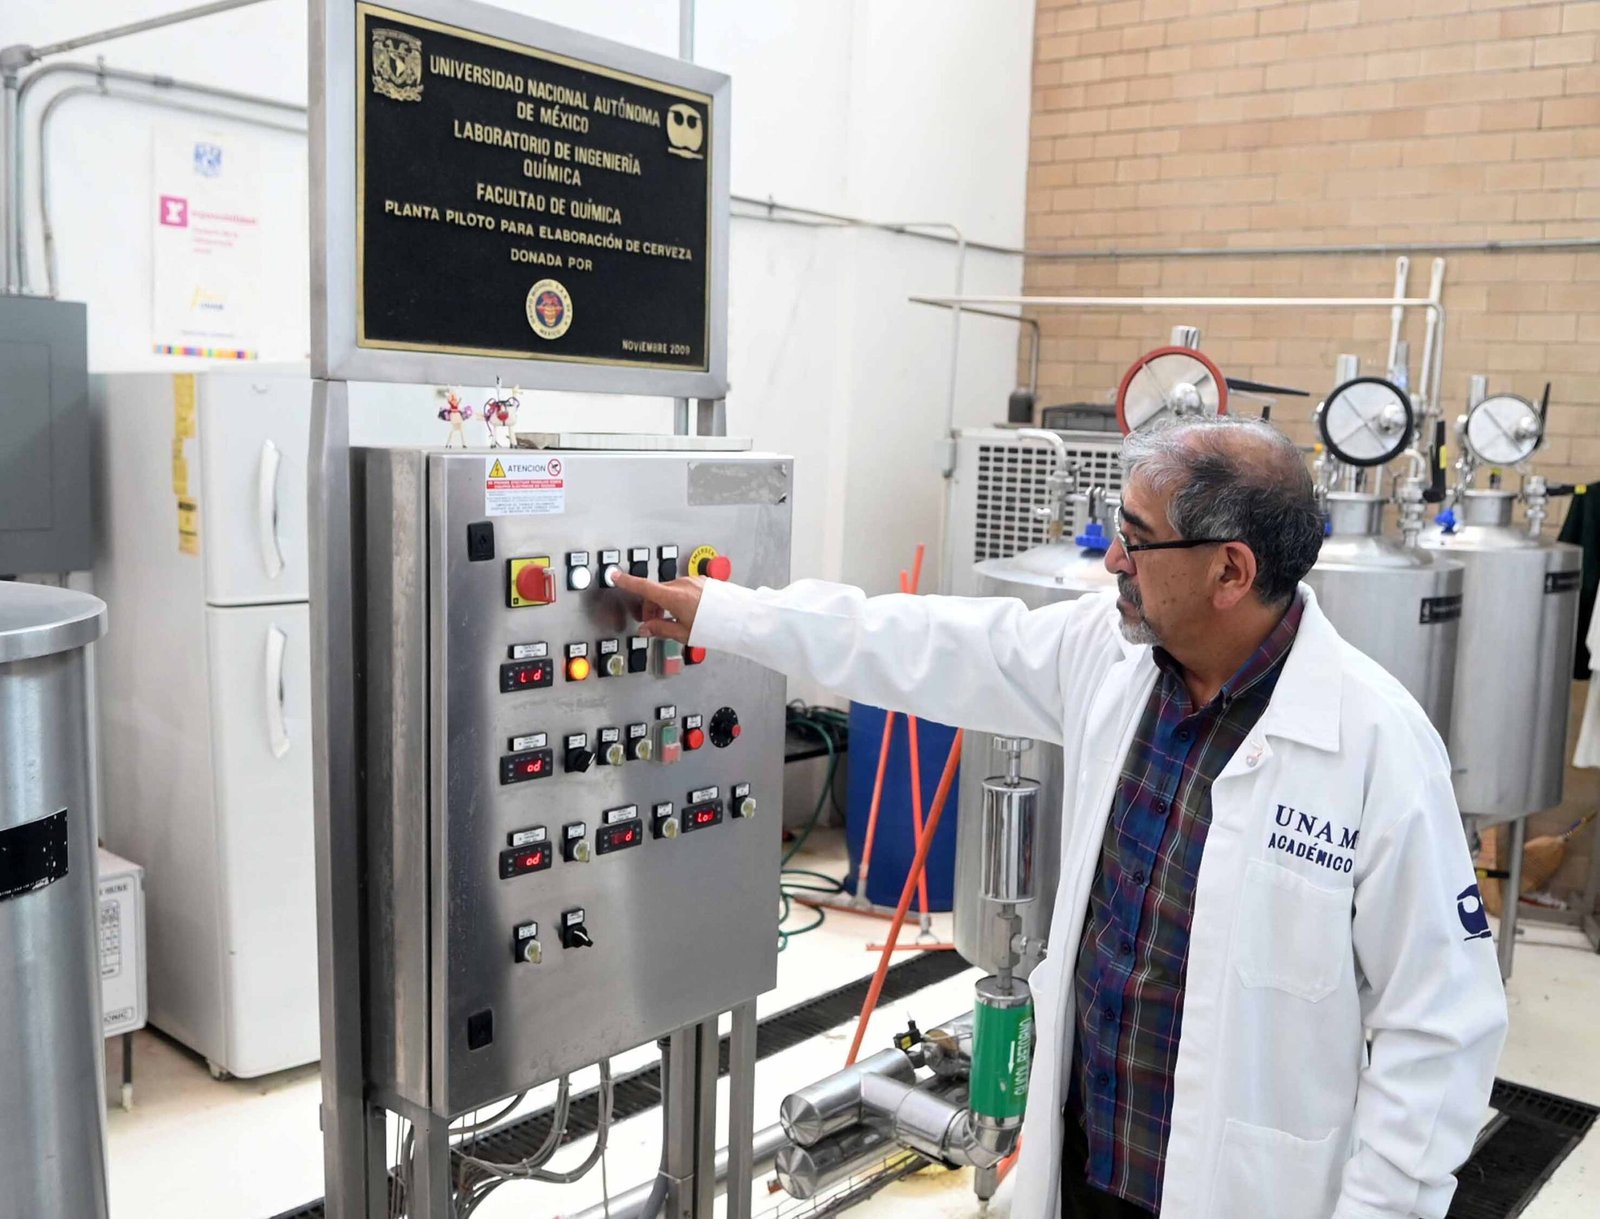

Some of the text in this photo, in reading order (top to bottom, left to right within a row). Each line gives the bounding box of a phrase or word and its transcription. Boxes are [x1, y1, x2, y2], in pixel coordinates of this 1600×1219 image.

[430, 54, 661, 128] UNIVERSIDAD NACIONAL AUTÓNOMA
[516, 101, 589, 134] DE MÉXICO
[454, 119, 642, 176] LABORATORIO DE INGENIERÍA
[523, 158, 582, 186] QUÍMICA
[476, 182, 622, 225] FACULTAD DE QUÍMICA
[384, 200, 693, 261] PLANTA PILOTO PARA ELABORACIÓN DE CERVEZA
[510, 248, 593, 271] DONADA POR
[622, 340, 668, 354] NOVIEMBRE
[1275, 804, 1360, 850] UNAM
[1268, 832, 1353, 874] ACADÉMICO
